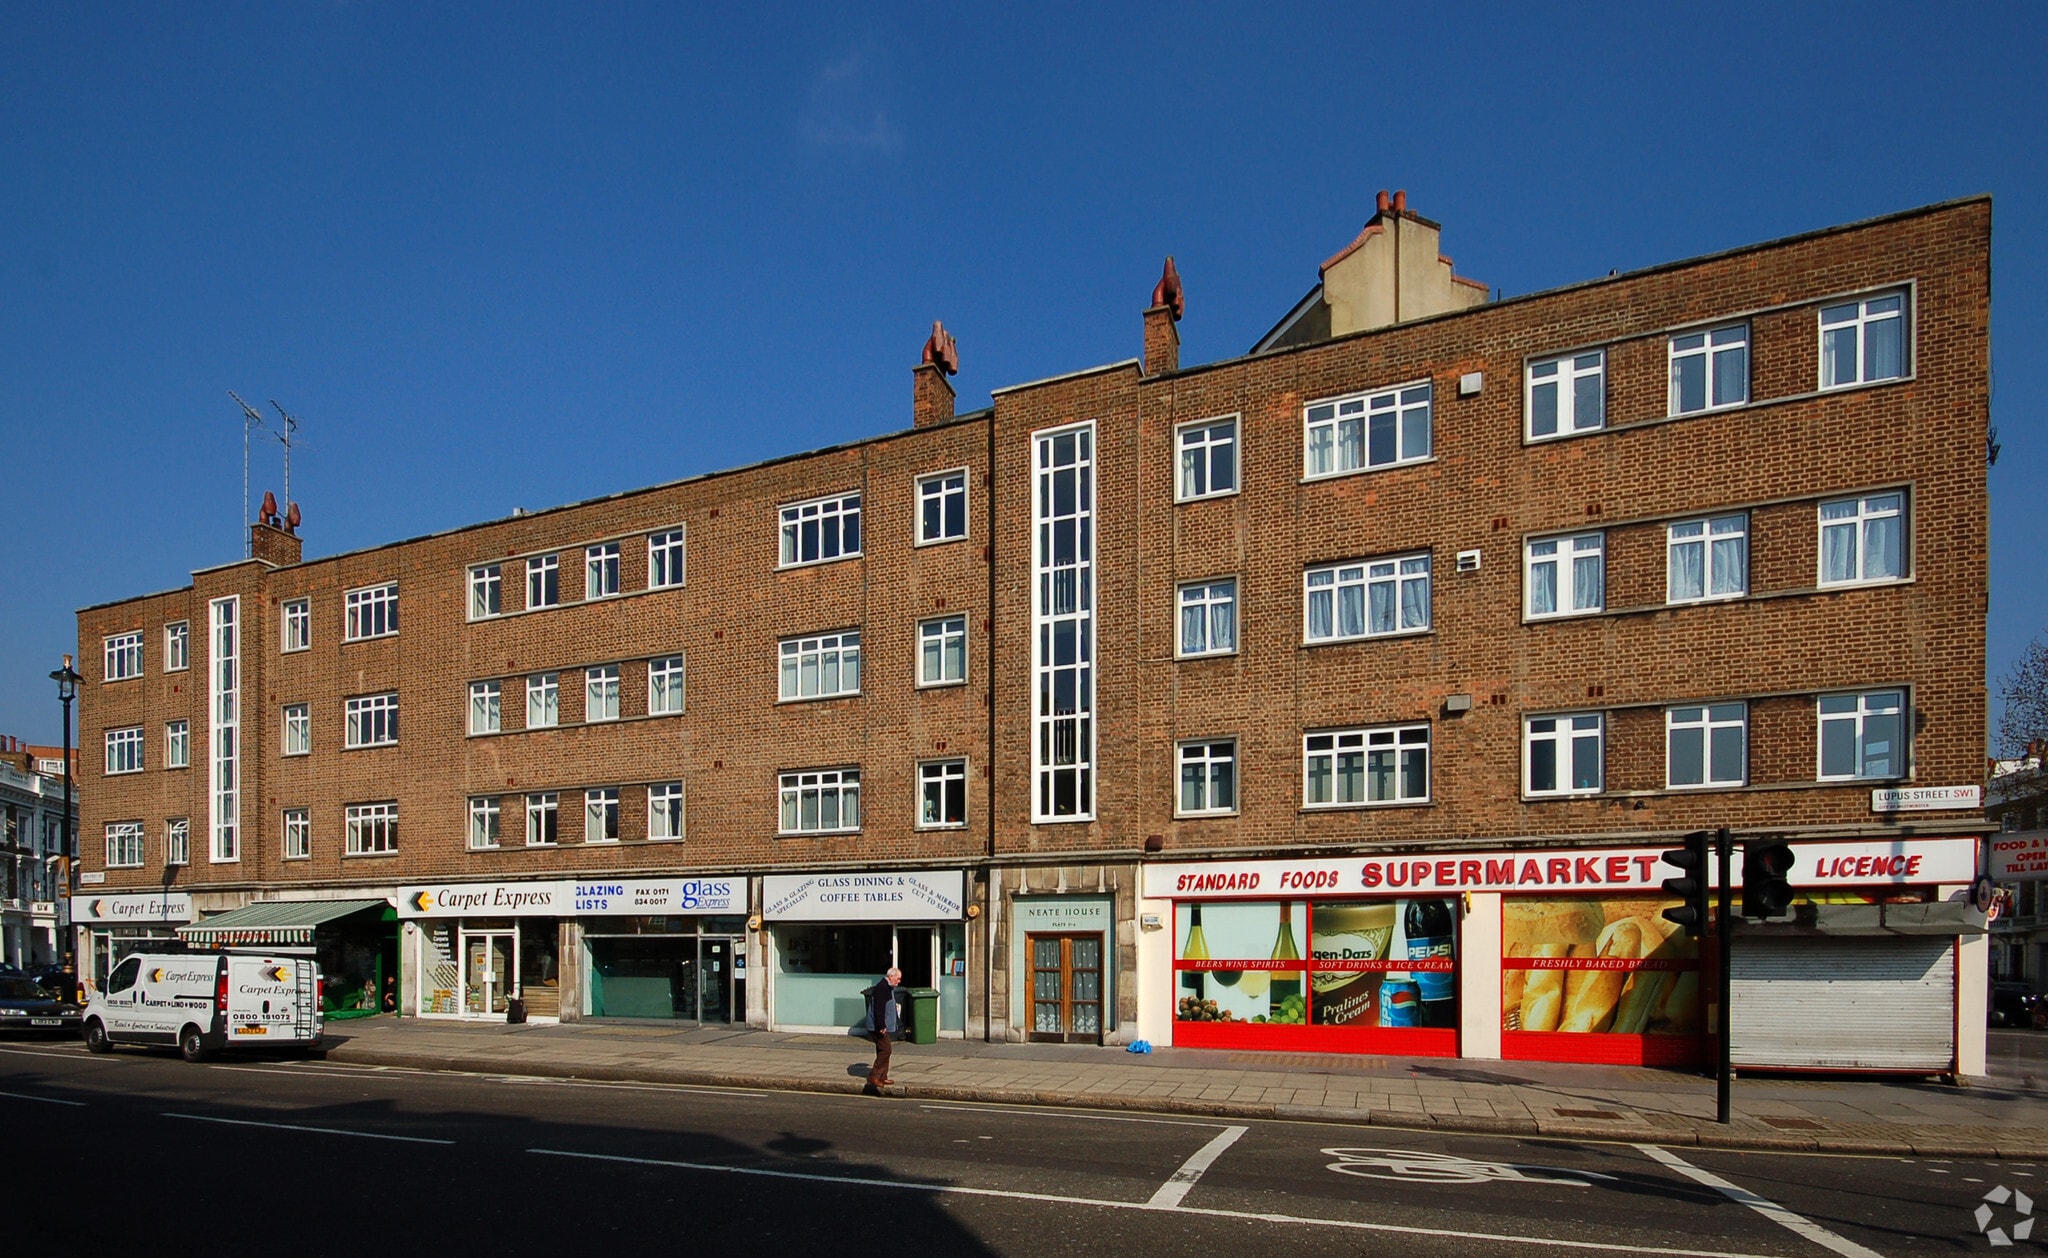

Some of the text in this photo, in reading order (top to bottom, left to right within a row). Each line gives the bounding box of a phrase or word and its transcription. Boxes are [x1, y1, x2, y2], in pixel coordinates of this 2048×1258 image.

[1878, 789, 1974, 801] LUPUS STREET SW1
[1993, 841, 2027, 851] FOOD
[2031, 839, 2040, 848] &
[2016, 851, 2046, 861] OPEN
[1176, 855, 1923, 892] STANDARD FOODS SUPERMARKET LICENCE
[2006, 863, 2026, 873] TILL
[817, 876, 905, 888] GLASS DINING &
[437, 887, 552, 910] Carpet Express
[635, 888, 669, 896] FAX 0171
[681, 879, 730, 910] glass
[764, 900, 783, 914] GLASS
[789, 878, 815, 899] GLAZING
[819, 892, 904, 903] COFFEE TABLES
[908, 877, 929, 893] GLASS
[935, 892, 961, 912] MIRROR
[697, 896, 730, 910] Express
[776, 891, 809, 915] SPECIALIST
[911, 888, 950, 915] CUT TO SIZE
[112, 900, 185, 917] Carpet Express
[1028, 908, 1101, 917] NEATE HOUSE
[1311, 947, 1372, 960] gen-Dazs
[1408, 943, 1452, 958] PEPSI
[1195, 960, 1286, 969] BEERS WINE SPIRITS
[1318, 961, 1454, 969] SOFT DRINKS & ICE CREAM
[1532, 959, 1668, 969] FRESHLY BAKED BREAD
[165, 970, 214, 984] Carpet Express
[239, 984, 272, 996] Carpet
[145, 1000, 167, 1008] CARPET
[1322, 990, 1369, 1018] Pralines
[1334, 1000, 1370, 1025] Cream
